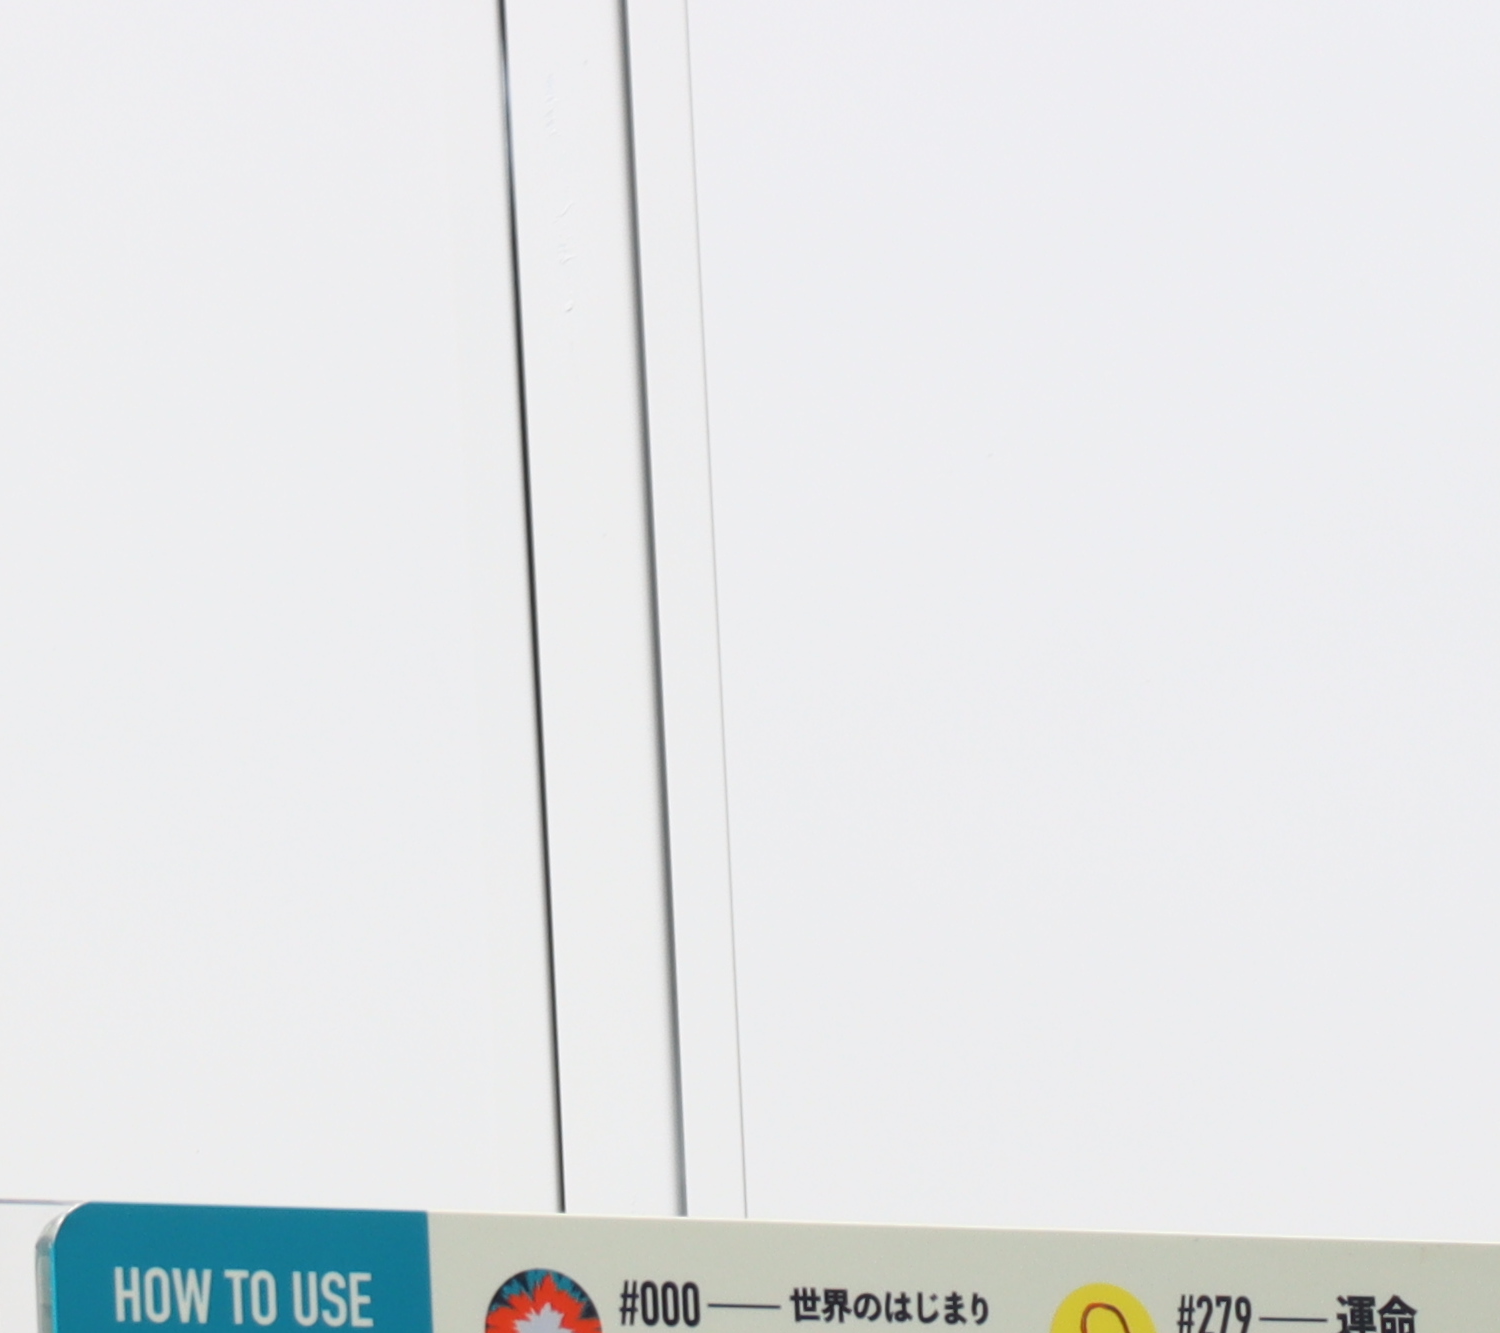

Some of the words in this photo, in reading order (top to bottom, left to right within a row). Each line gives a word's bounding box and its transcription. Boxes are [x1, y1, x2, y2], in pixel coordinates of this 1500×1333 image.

[114, 1267, 211, 1324] HOW
[224, 1270, 278, 1325] TO
[293, 1272, 374, 1327] USE
[619, 1280, 701, 1327] #000
[790, 1288, 989, 1325] 世界のはじまり
